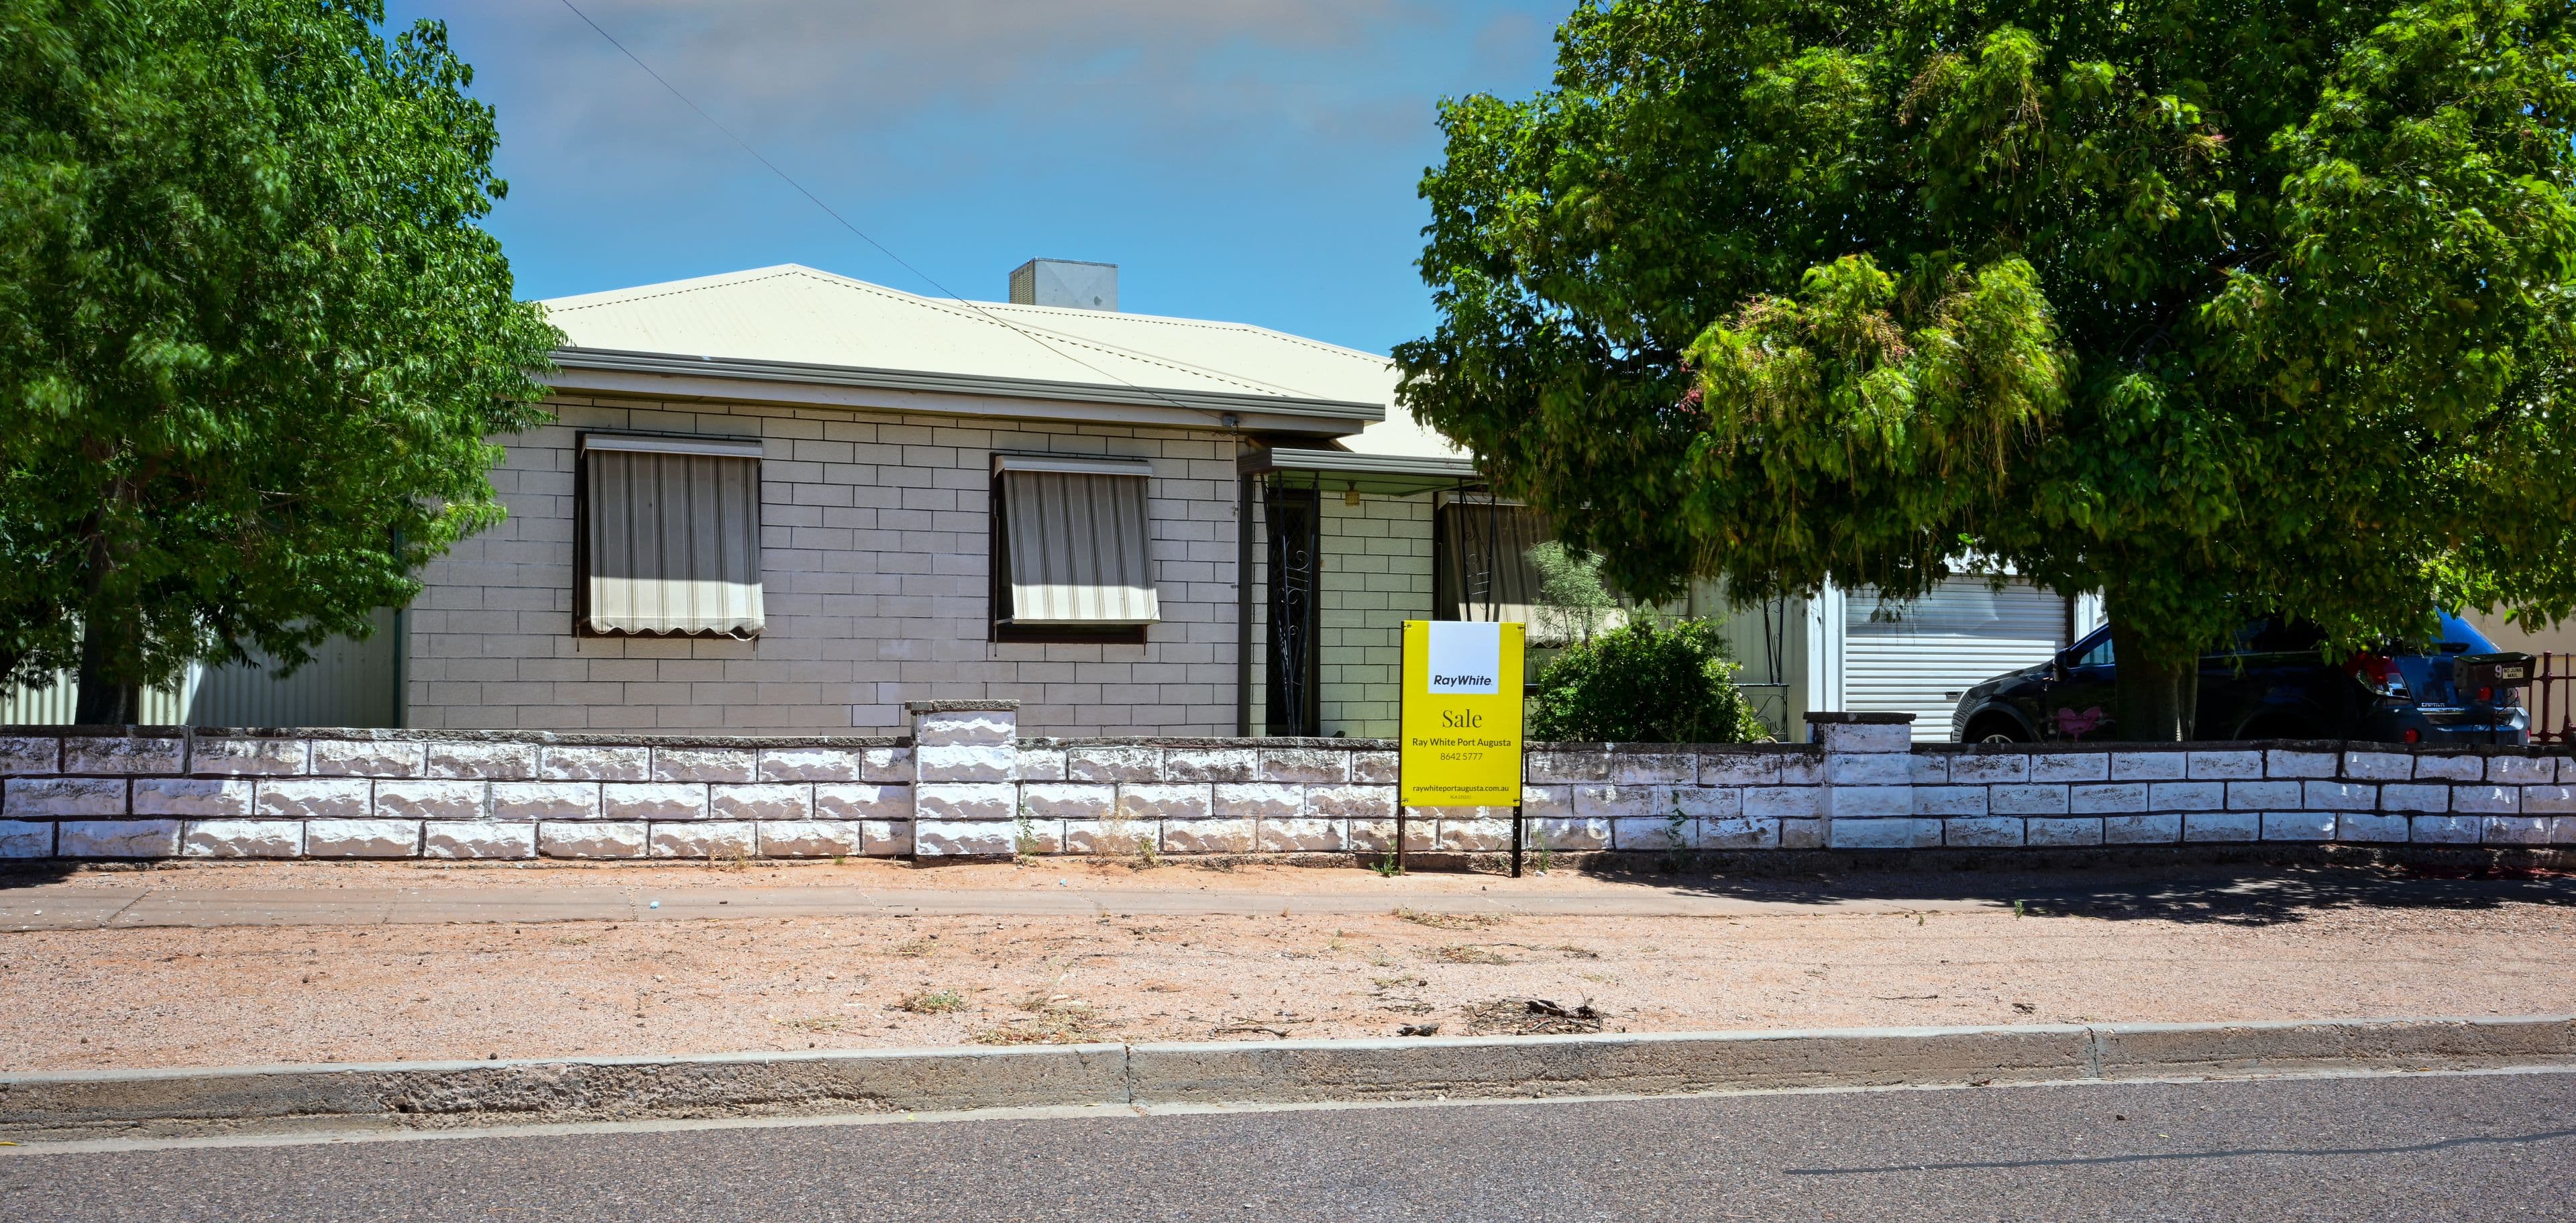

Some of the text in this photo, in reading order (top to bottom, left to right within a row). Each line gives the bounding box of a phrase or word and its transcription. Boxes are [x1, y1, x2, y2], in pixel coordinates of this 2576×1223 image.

[2495, 664, 2502, 678] 9
[1442, 709, 1482, 728] Sale
[1412, 738, 1511, 747] Ray White Port Augusta
